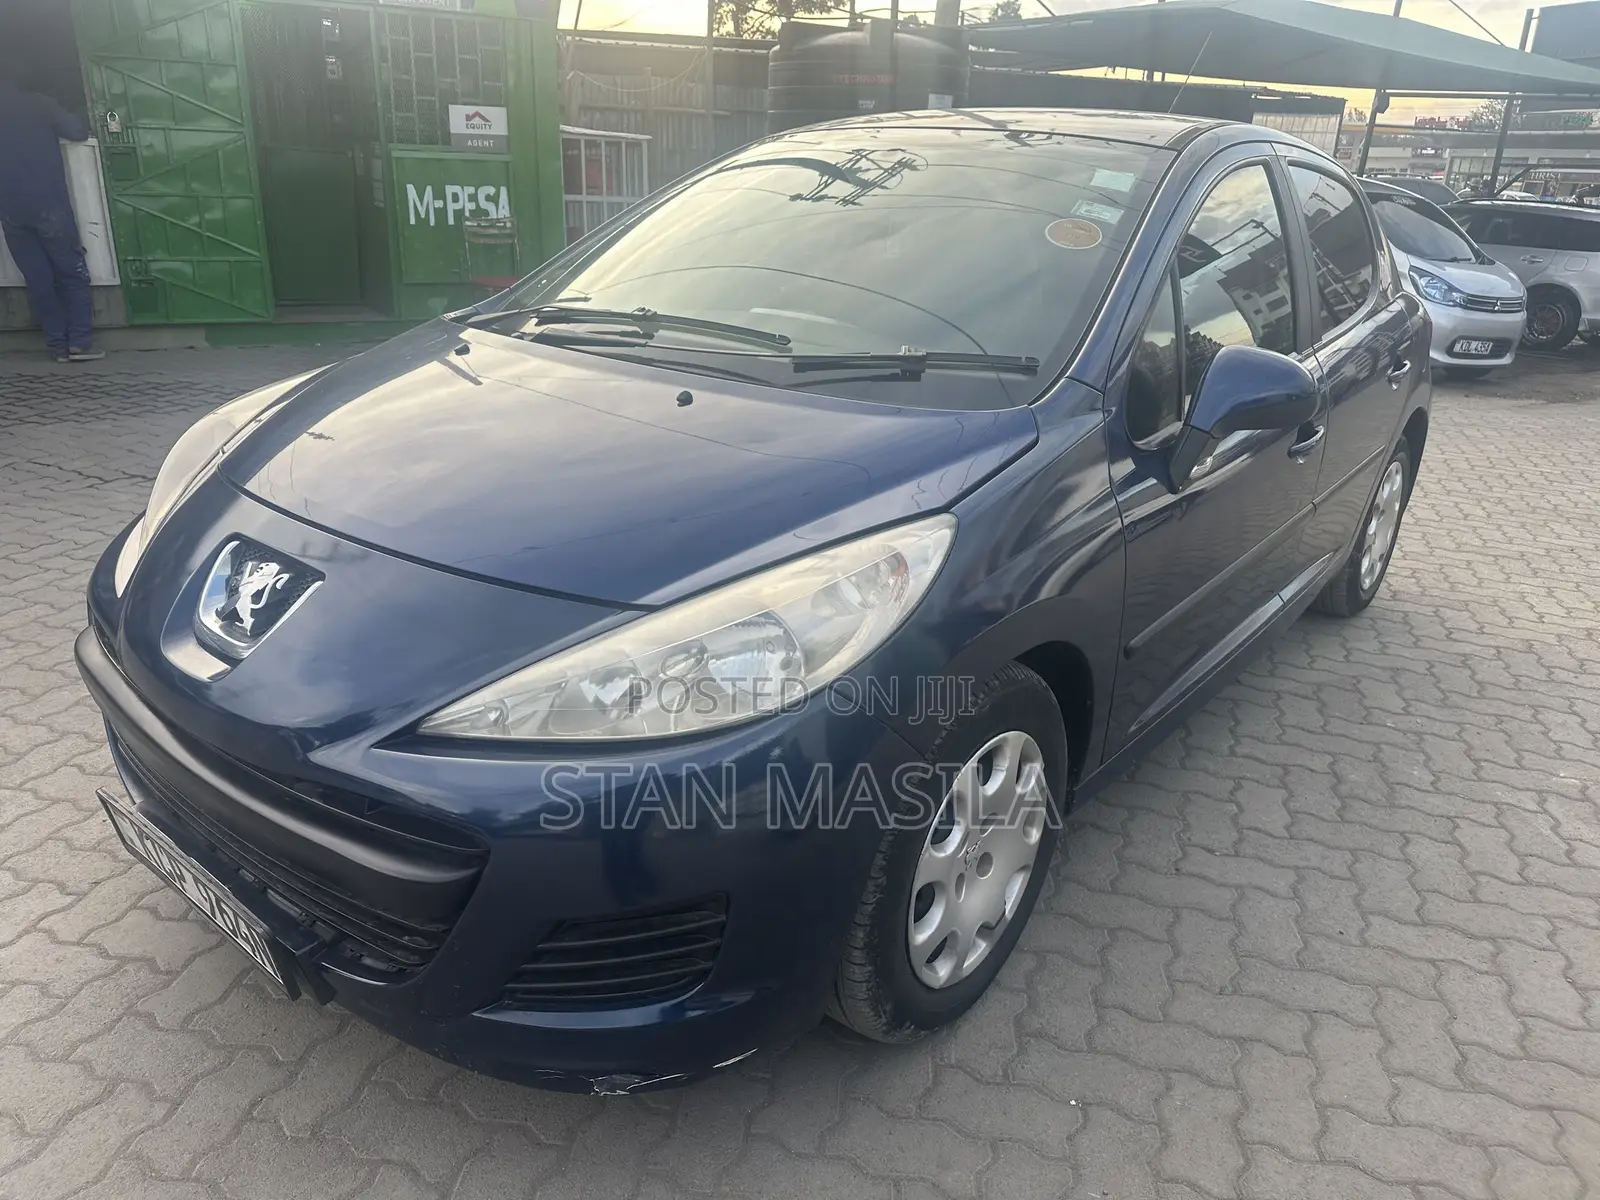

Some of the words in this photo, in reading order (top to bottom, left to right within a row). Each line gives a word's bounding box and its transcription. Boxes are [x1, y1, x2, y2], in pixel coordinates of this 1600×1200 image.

[465, 122, 493, 131] EQUITY
[467, 139, 495, 148] AGENT
[406, 183, 511, 226] M-PESA
